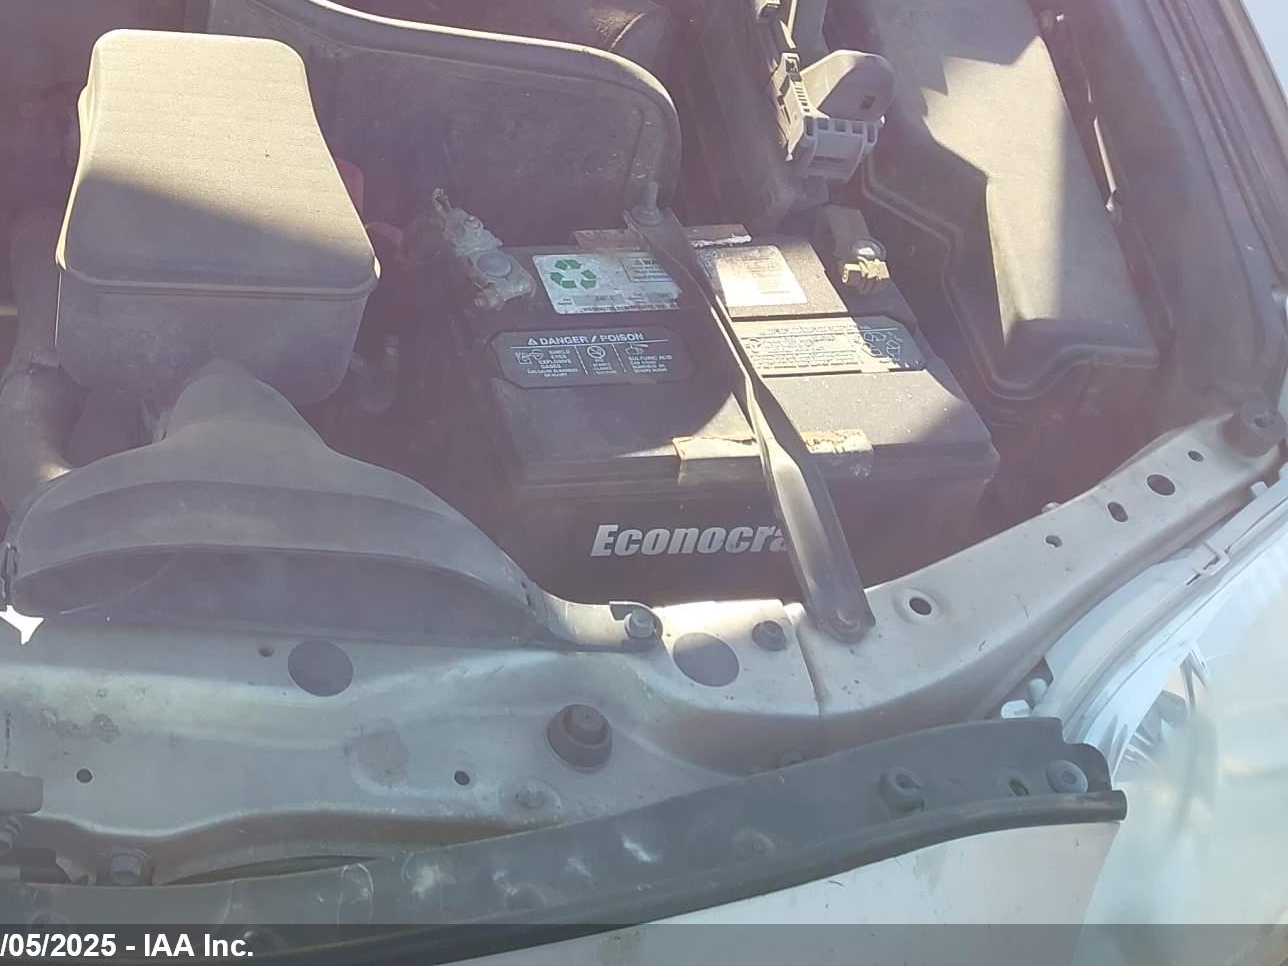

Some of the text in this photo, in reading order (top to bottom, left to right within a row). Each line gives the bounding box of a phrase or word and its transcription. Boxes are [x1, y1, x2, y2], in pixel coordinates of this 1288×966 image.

[539, 335, 589, 345] DANGER
[600, 332, 644, 342] POISON
[590, 524, 787, 557] Econocra
